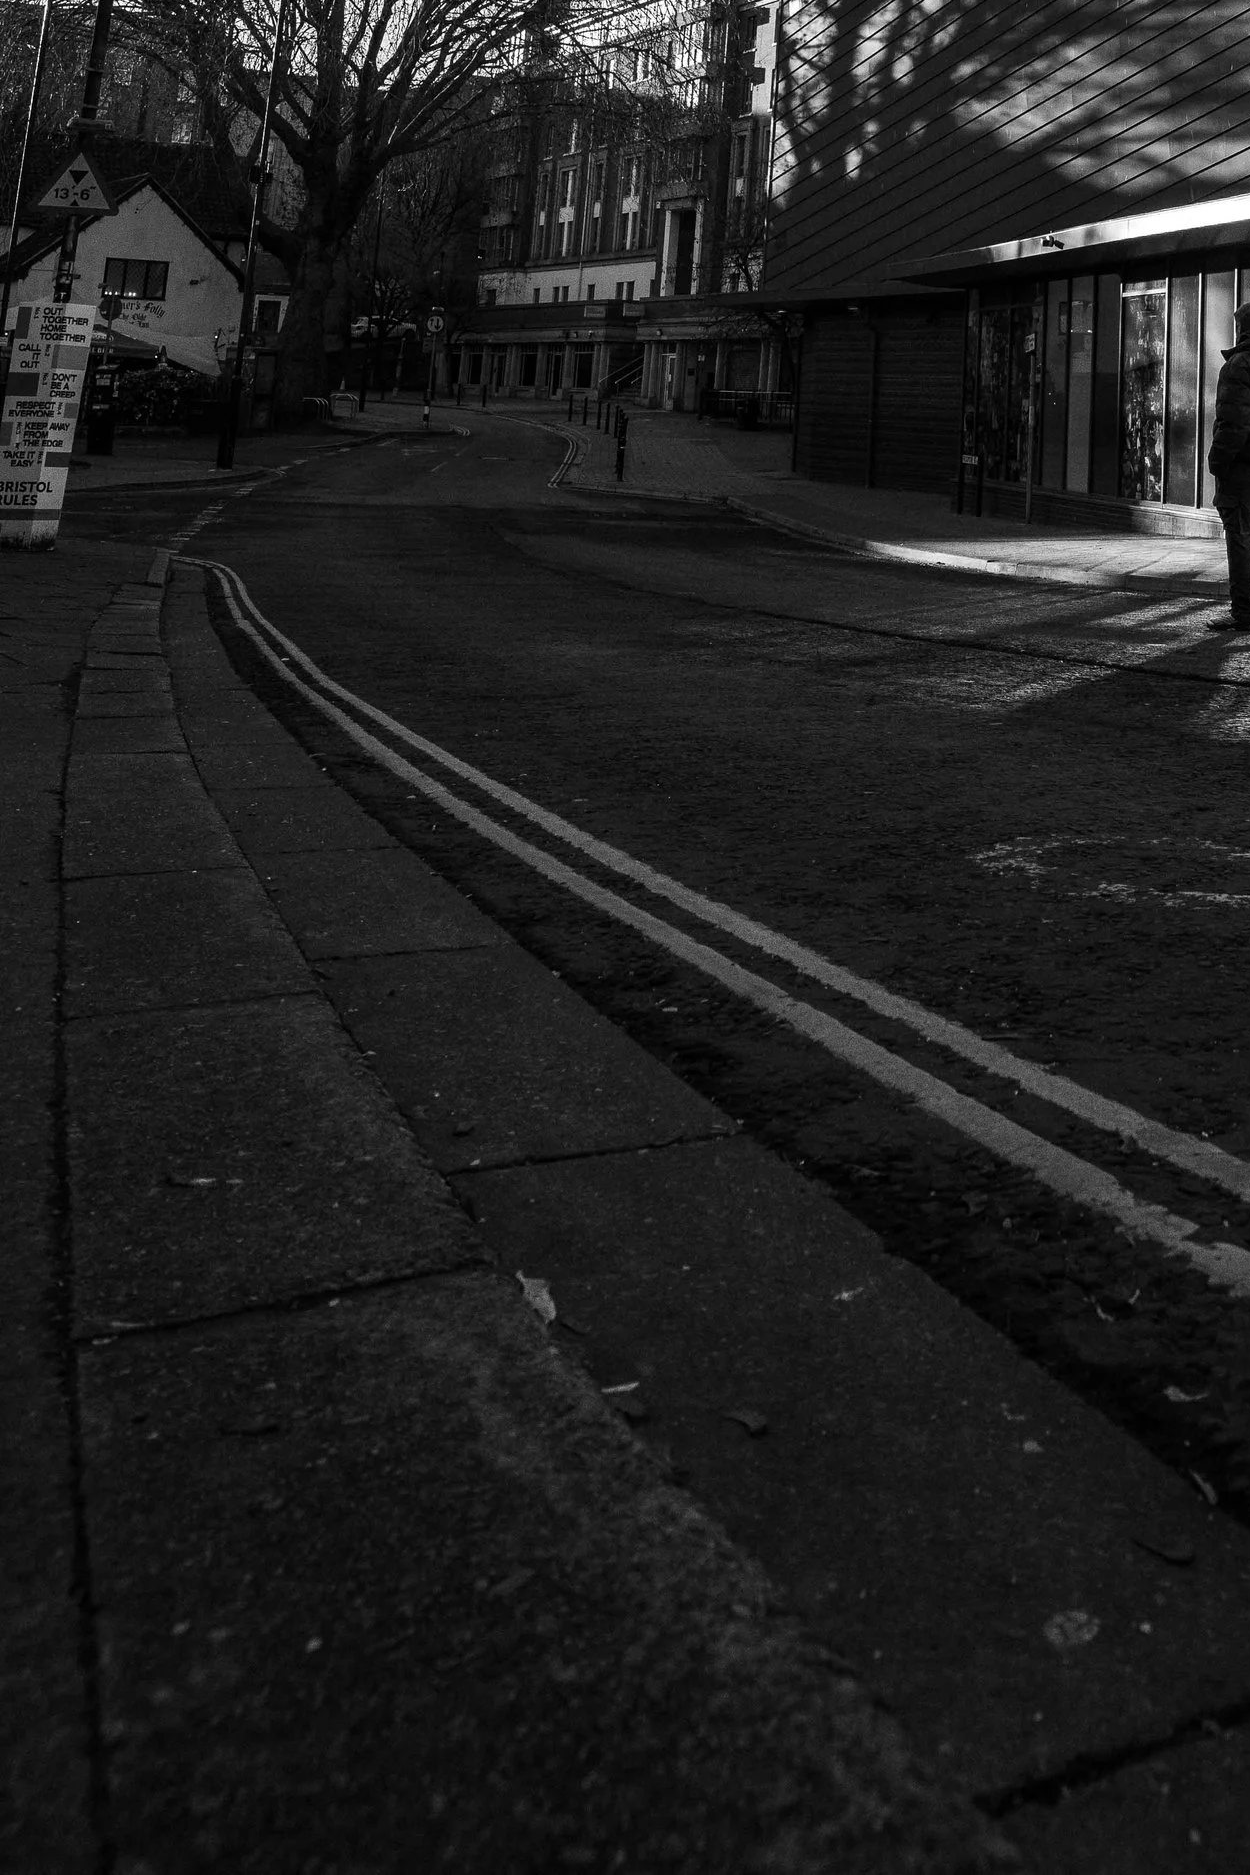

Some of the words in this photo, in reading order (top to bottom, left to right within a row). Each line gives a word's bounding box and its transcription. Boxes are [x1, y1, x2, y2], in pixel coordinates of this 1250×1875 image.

[43, 307, 63, 315] OUT
[42, 316, 89, 326] TOGETHER
[40, 324, 67, 333] HOME
[40, 332, 86, 343] TOGETHER
[18, 343, 41, 352] CALL
[32, 352, 41, 360] IT
[20, 360, 40, 369] OUT
[52, 373, 77, 382] DON'T
[50, 381, 62, 389] BE
[63, 382, 70, 390] A
[49, 390, 76, 398] CREEP
[16, 401, 56, 410] RESPECT
[8, 409, 55, 418] EVERYONE
[24, 422, 48, 430] KEEP
[49, 422, 70, 431] AWAY
[23, 430, 49, 439] FROM
[23, 439, 40, 447] THE
[41, 439, 63, 447] EDGE
[3, 451, 25, 459] TAKE
[27, 451, 36, 459] IT
[10, 459, 34, 467] EASY
